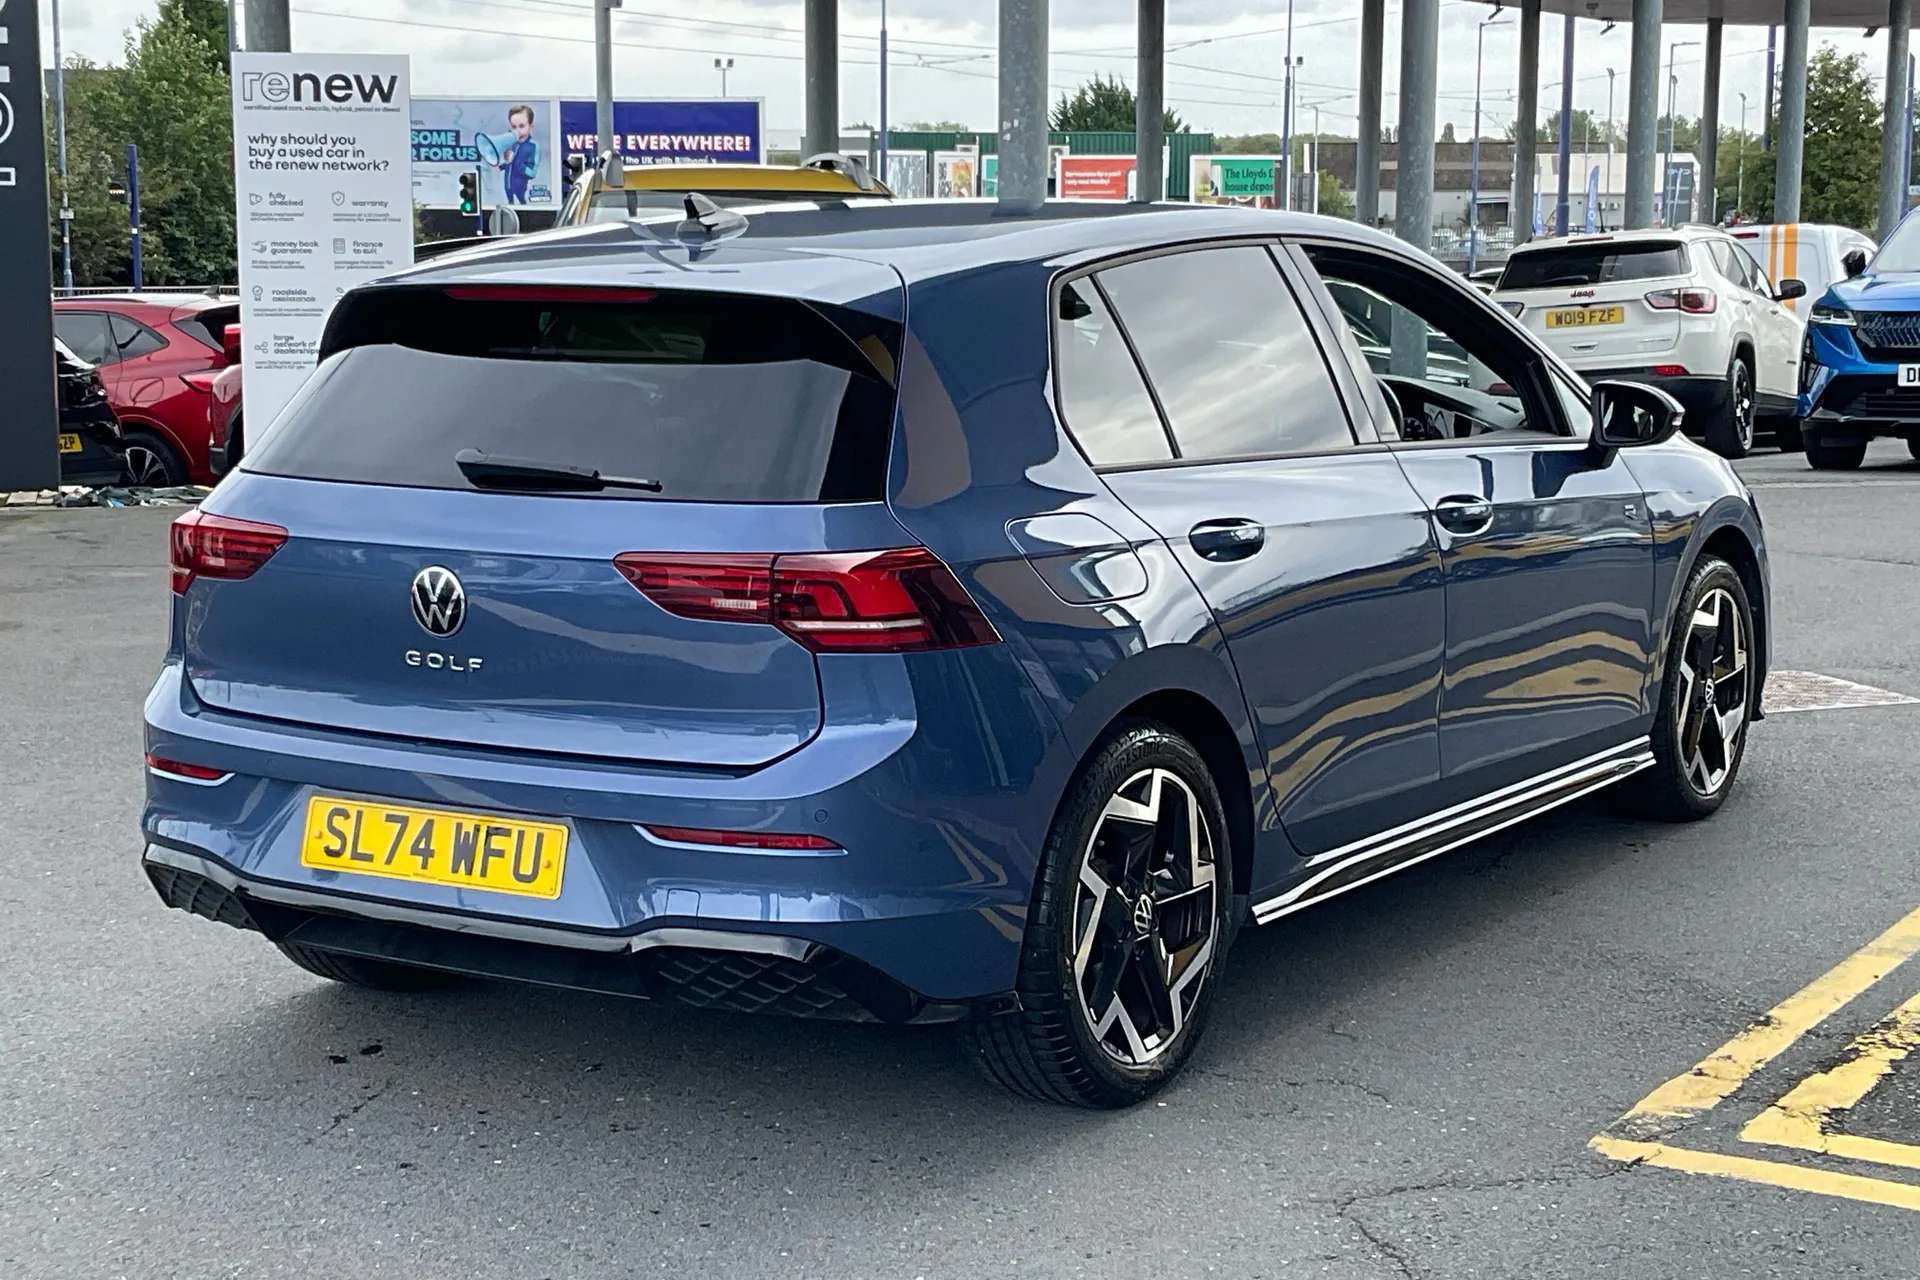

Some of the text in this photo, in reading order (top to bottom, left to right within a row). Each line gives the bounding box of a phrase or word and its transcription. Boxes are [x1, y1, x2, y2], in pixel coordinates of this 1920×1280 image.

[242, 72, 398, 103] renew
[248, 133, 356, 148] why should you
[567, 135, 751, 151] WE'E EVERYWHERE!
[248, 146, 365, 160] buy a used car in
[421, 148, 454, 160] FOR
[456, 148, 478, 160] US
[249, 159, 389, 172] the renew network?
[1225, 168, 1240, 179] The
[1242, 168, 1267, 182] Lloyds
[1589, 308, 1617, 323] FZF
[405, 650, 483, 673] GOLF
[324, 807, 545, 883] SL74 WFU
